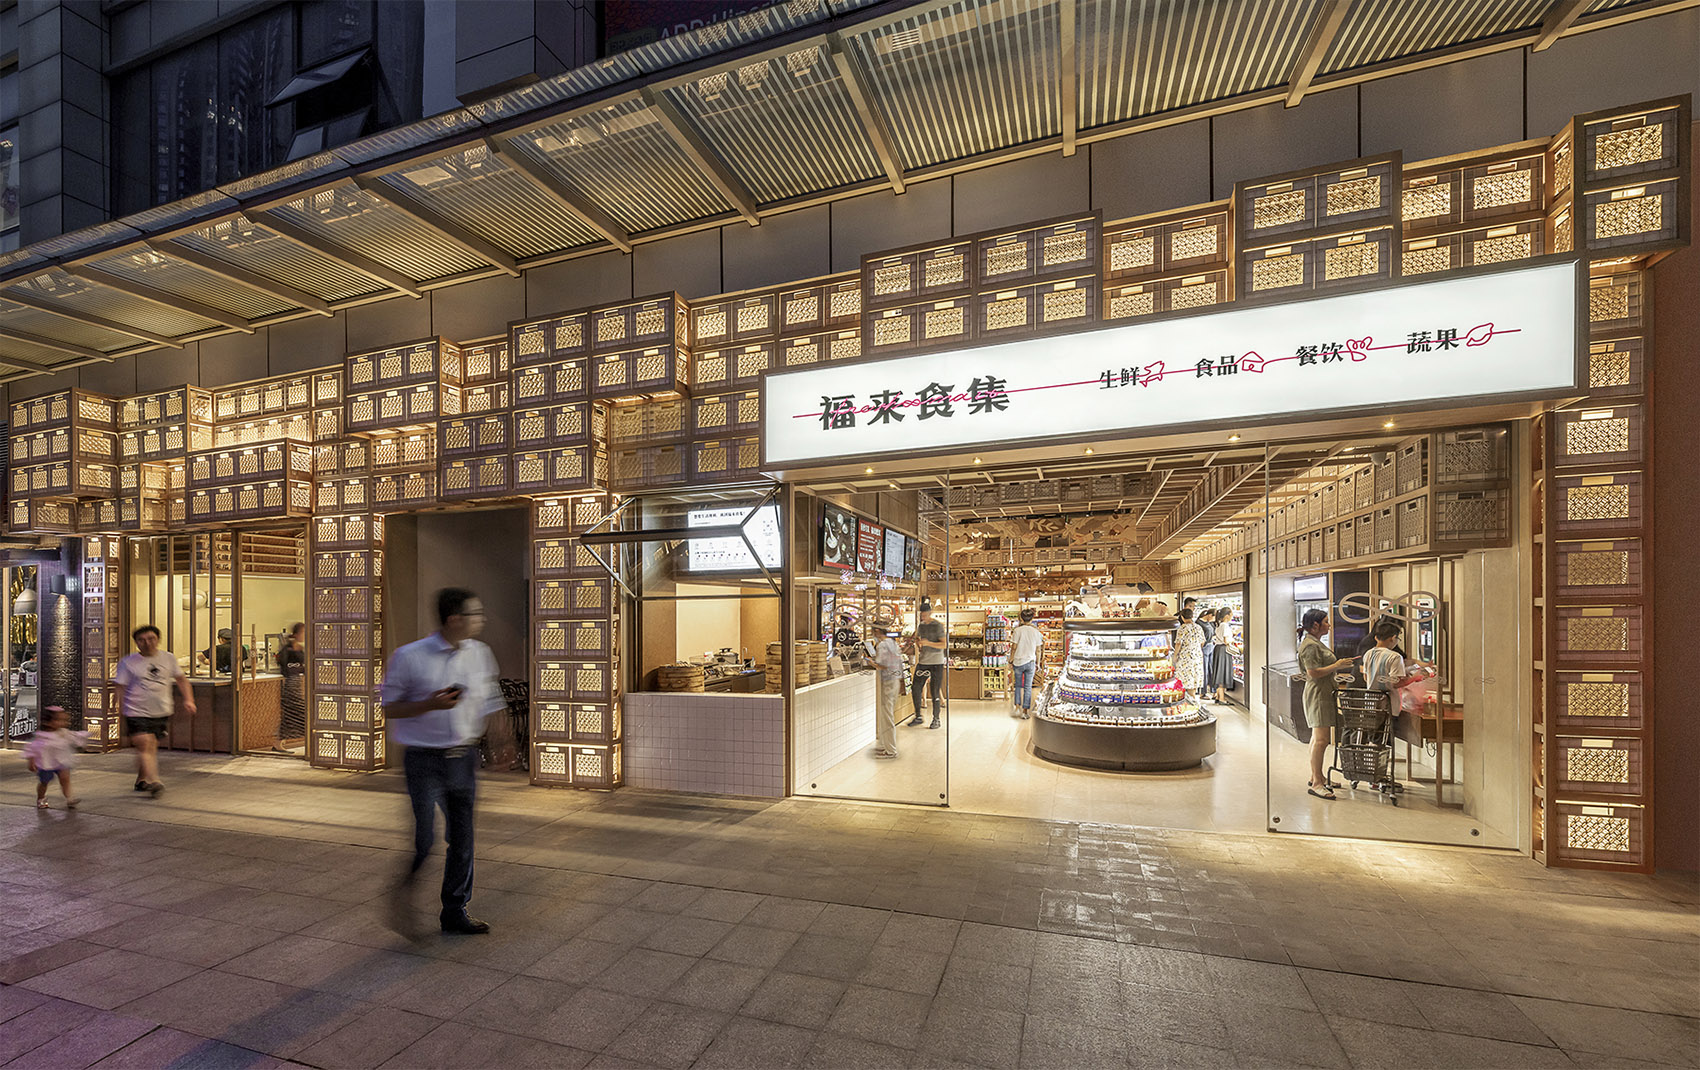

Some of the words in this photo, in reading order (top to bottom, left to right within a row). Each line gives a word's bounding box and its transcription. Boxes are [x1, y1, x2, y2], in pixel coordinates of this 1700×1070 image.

[1296, 342, 1344, 366] 餐饮
[1406, 328, 1459, 354] 蔬果
[1195, 351, 1239, 378] 食品
[1099, 366, 1140, 390] 生鲜
[819, 375, 1010, 431] 福来食集
